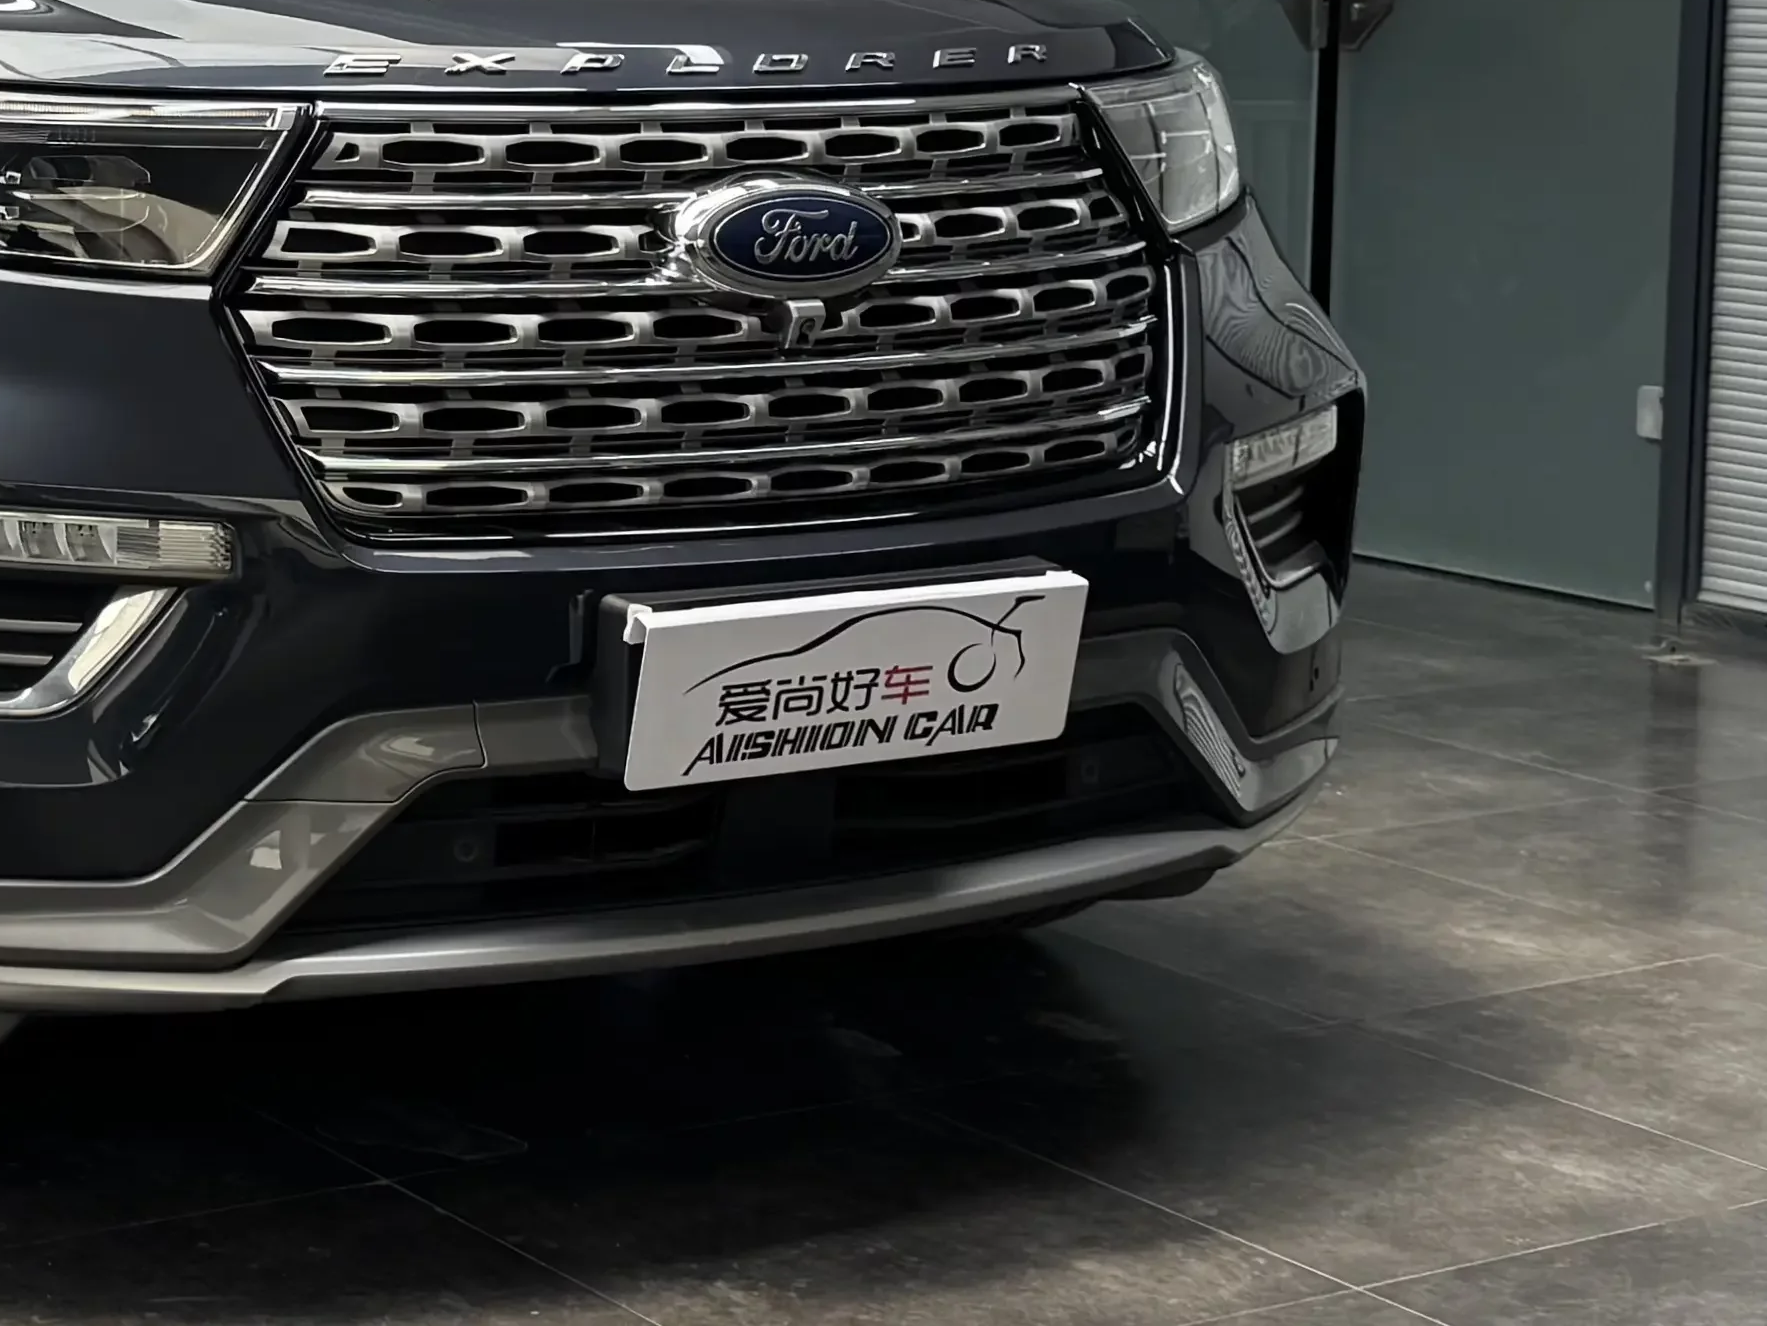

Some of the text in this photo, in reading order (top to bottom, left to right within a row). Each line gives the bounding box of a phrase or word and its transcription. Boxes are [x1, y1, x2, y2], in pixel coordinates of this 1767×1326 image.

[322, 43, 1047, 75] EXPLORER
[754, 208, 860, 264] Ford
[714, 664, 934, 727] 爱尚好车
[680, 702, 999, 776] AISHION CAR
